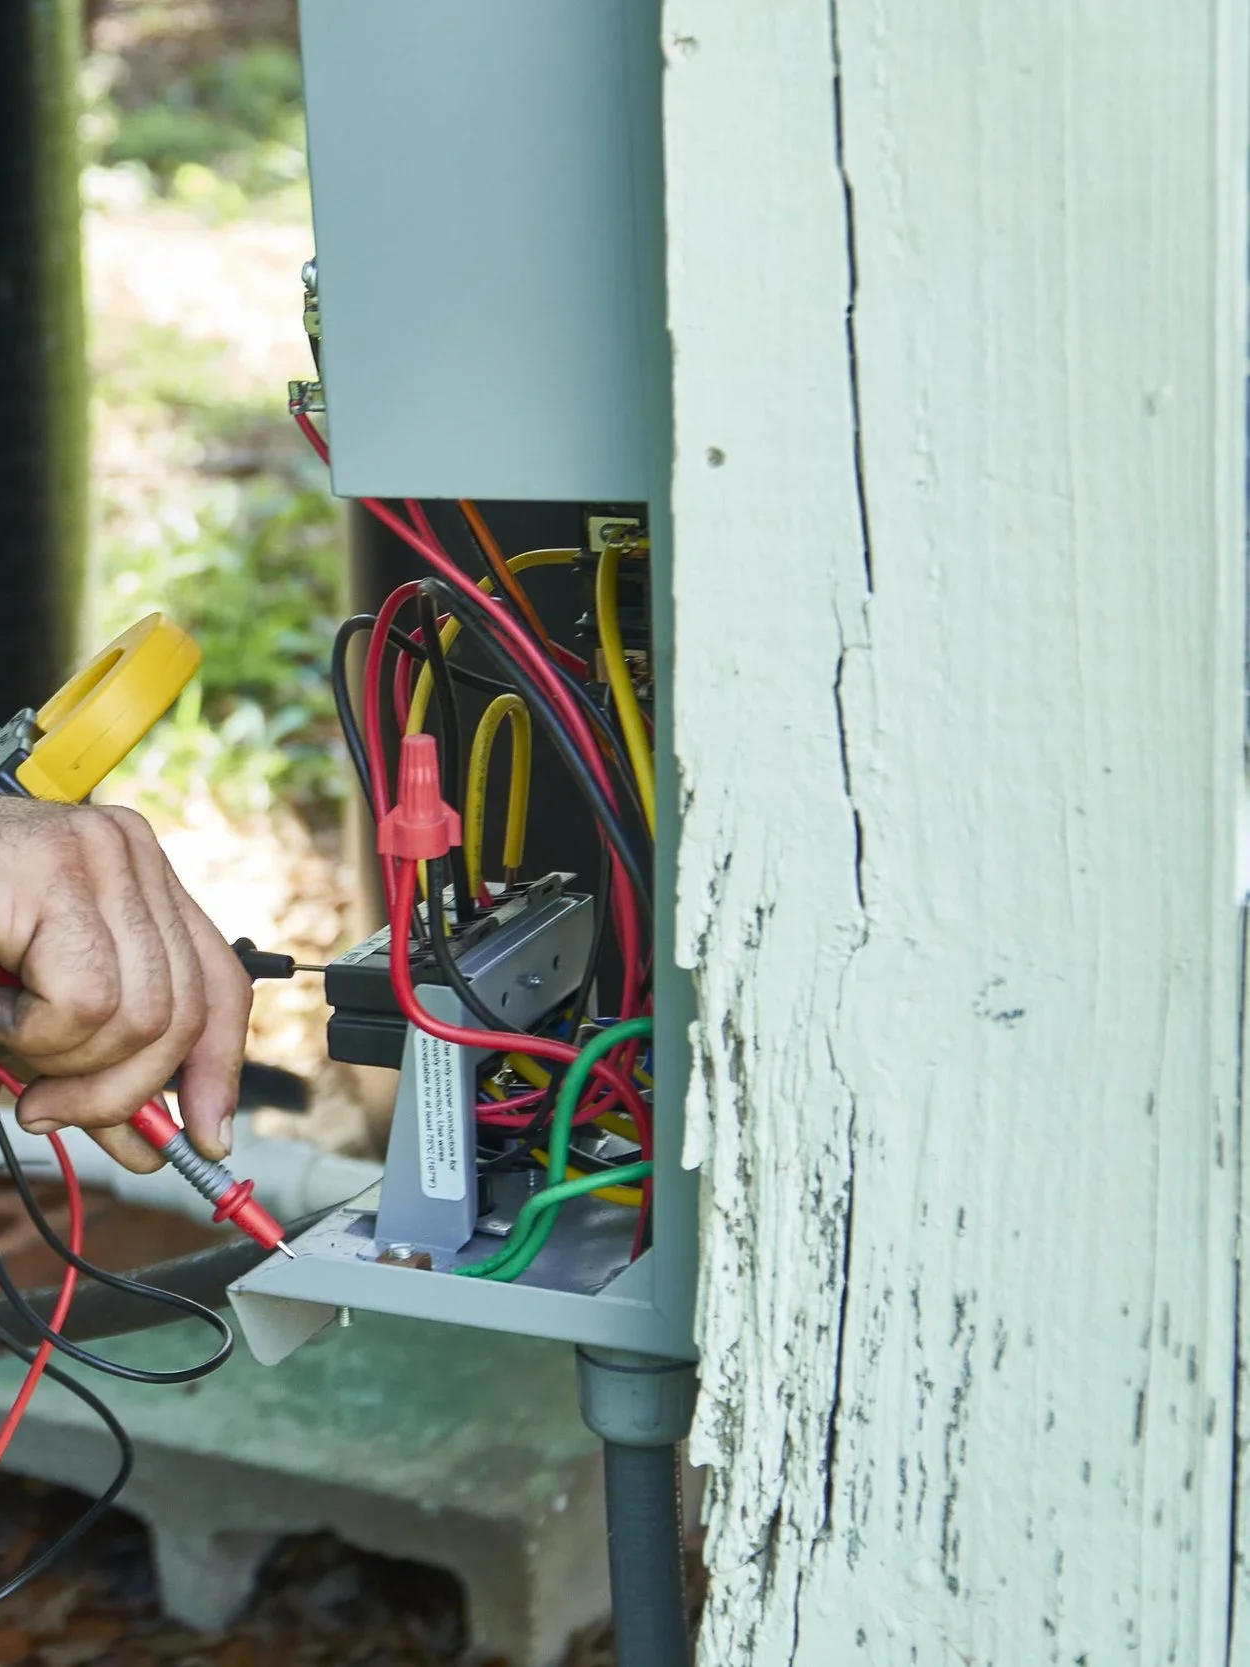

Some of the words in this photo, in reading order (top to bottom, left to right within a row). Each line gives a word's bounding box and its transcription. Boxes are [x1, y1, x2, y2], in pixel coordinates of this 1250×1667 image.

[421, 1038, 432, 1084] acceptable
[433, 1039, 442, 1066] supply
[445, 1059, 453, 1076] only
[424, 1086, 432, 1097] for
[445, 1079, 454, 1108] copper
[425, 1100, 432, 1109] at
[425, 1111, 434, 1131] least
[437, 1120, 445, 1137] Use
[447, 1111, 456, 1157] conductors
[449, 1160, 458, 1171] for
